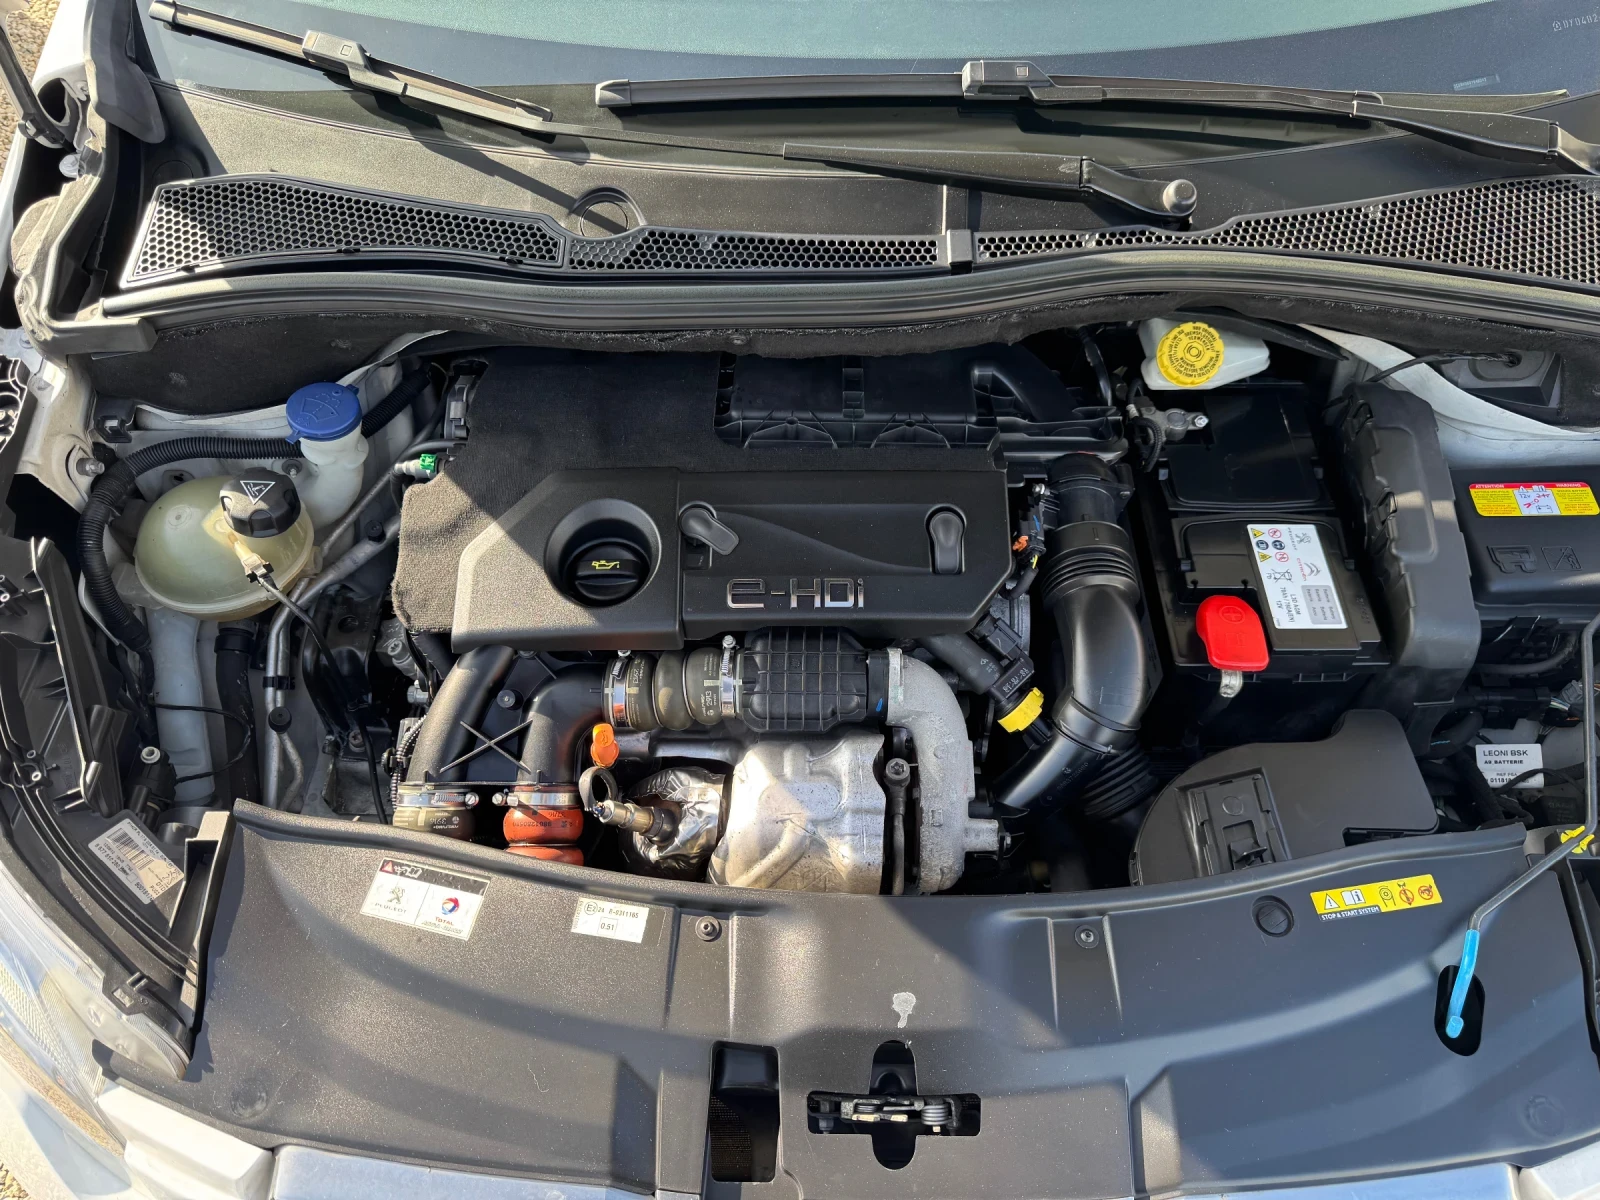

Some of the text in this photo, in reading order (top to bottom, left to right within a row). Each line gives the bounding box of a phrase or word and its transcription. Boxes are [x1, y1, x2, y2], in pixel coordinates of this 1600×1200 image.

[375, 902, 407, 913] PEUGEOT
[1359, 907, 1379, 915] SYSTEM
[435, 916, 454, 926] TOTAL
